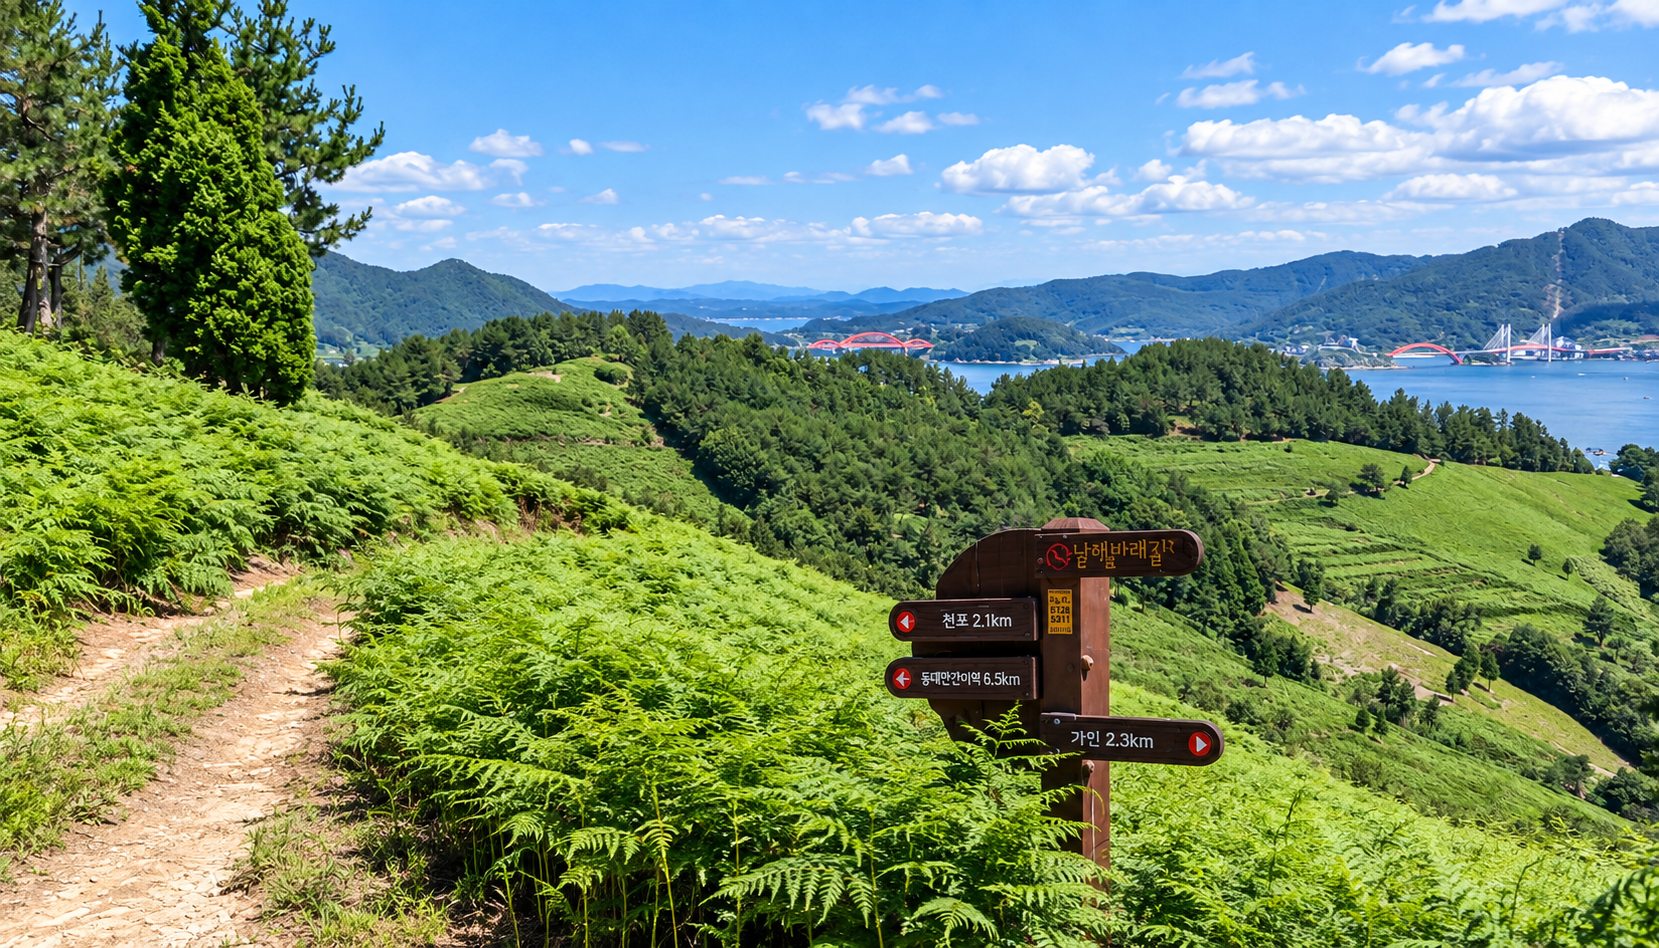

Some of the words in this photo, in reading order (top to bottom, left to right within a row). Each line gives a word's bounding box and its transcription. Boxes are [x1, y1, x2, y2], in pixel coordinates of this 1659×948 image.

[942, 612, 969, 629] 천포
[972, 613, 1012, 628] 2.1km
[983, 671, 1021, 686] 6.5km
[1070, 730, 1100, 748] 가인
[1105, 732, 1154, 749] 2.3km
